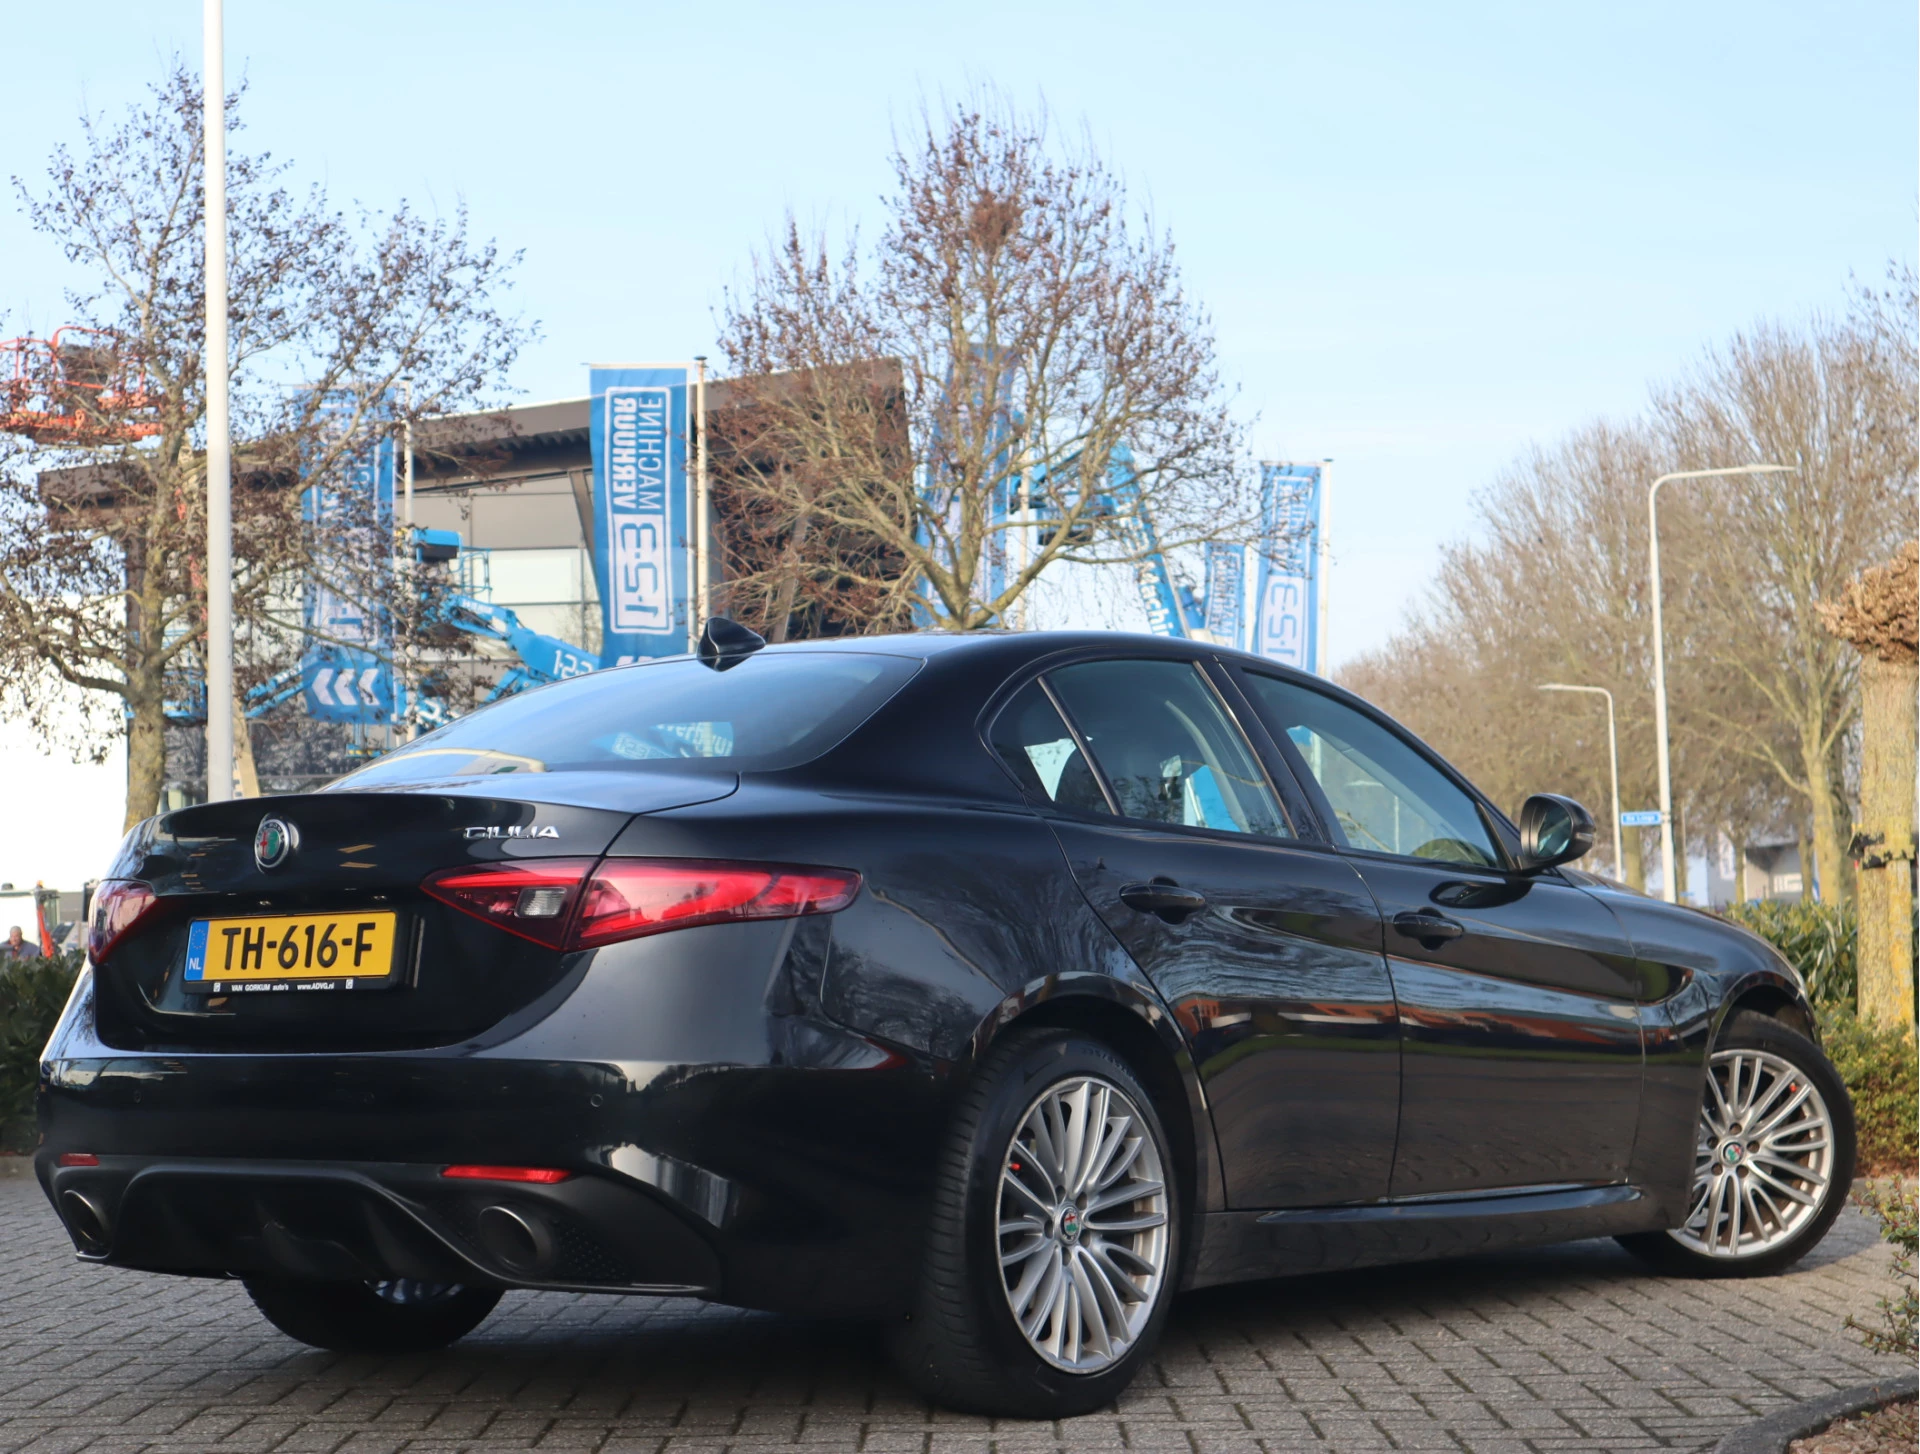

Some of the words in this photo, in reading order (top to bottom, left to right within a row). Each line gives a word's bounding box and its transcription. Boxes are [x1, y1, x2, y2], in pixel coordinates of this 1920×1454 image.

[463, 825, 560, 839] GIULIA
[222, 922, 376, 970] TH-616-F
[188, 957, 201, 970] NL
[245, 983, 270, 991] GORKUM
